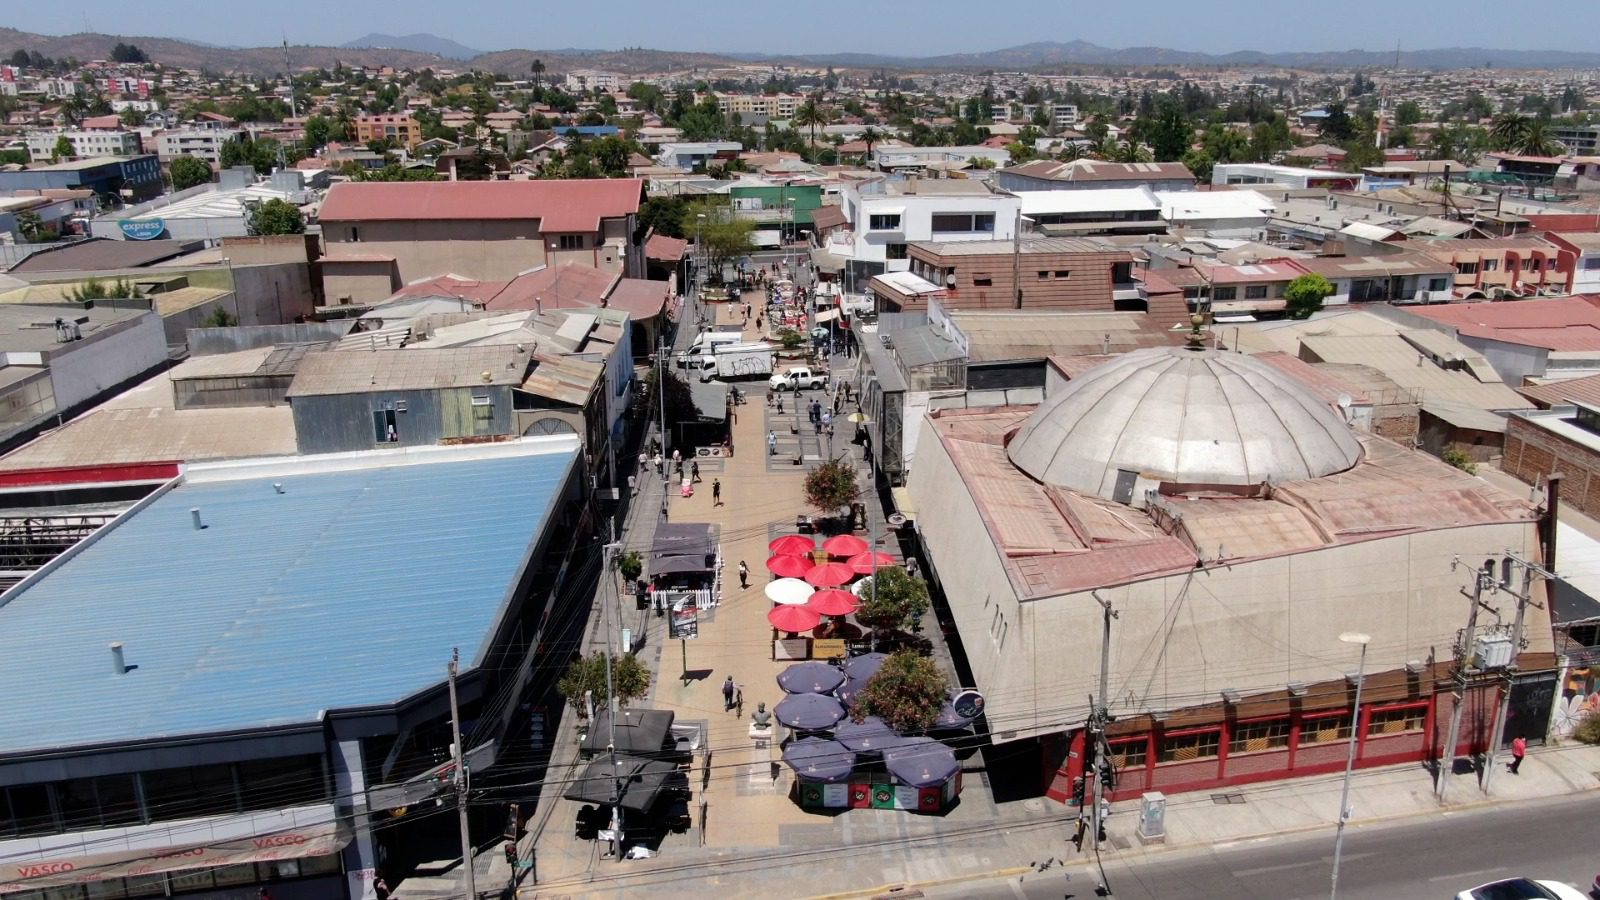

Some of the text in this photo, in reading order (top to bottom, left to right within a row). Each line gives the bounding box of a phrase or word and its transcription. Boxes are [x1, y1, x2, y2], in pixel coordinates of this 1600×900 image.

[122, 222, 160, 231] express
[253, 834, 305, 849] VASCO
[17, 862, 74, 877] VASCO
